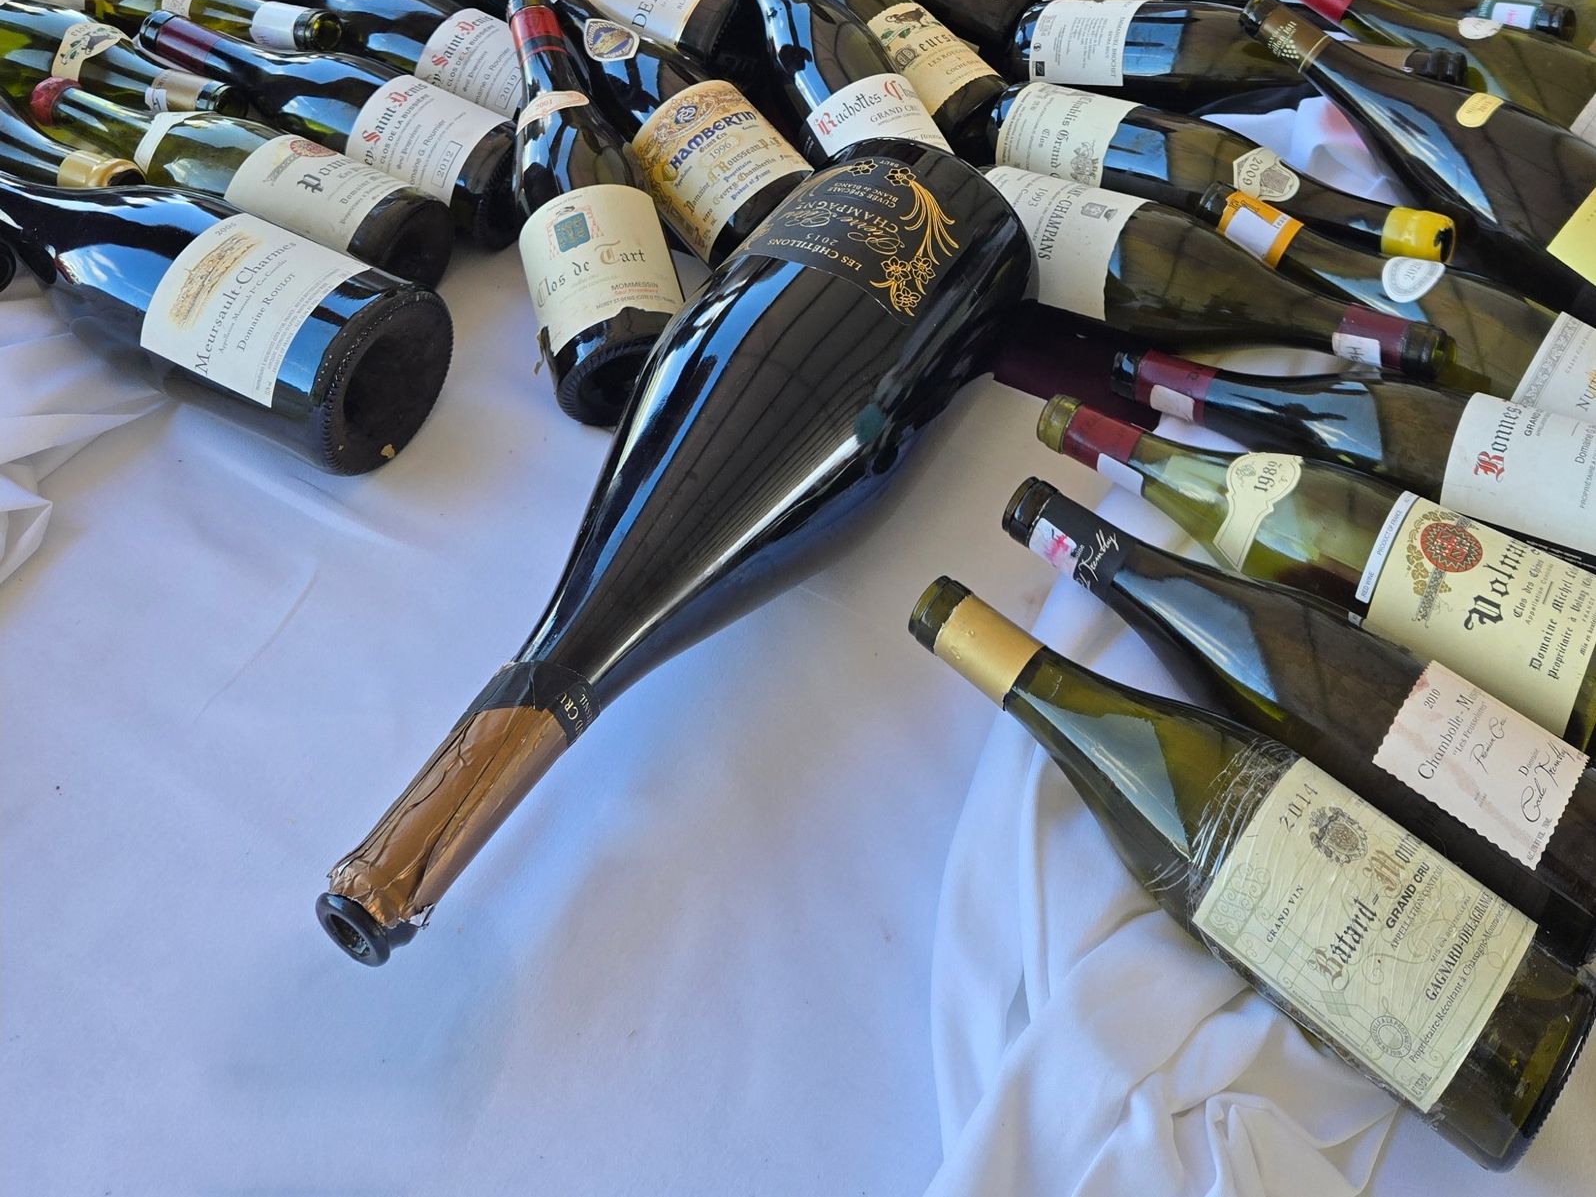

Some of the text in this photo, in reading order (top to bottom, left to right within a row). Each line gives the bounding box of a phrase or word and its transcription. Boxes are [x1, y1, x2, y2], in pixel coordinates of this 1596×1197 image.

[895, 33, 957, 72] Meurs
[500, 74, 518, 101] 2019
[870, 106, 904, 124] GRAND
[380, 140, 392, 165] CLOS
[388, 128, 398, 143] DE
[409, 156, 422, 187] omaine
[424, 118, 447, 147] Roumier
[709, 141, 733, 160] 1996
[1038, 127, 1051, 149] Clos
[1050, 128, 1070, 174] Grand
[436, 150, 455, 179] 2012
[879, 159, 901, 168] BRUT
[1241, 154, 1264, 187] 2009
[826, 186, 897, 210] CUVÉE SPÉCIALE
[870, 189, 900, 203] BLANC
[1026, 186, 1050, 210] 1993
[215, 221, 238, 237] 2005
[572, 261, 591, 277] de
[767, 237, 863, 271] LES CHÉTILLONS
[610, 281, 659, 292] MOMMESSIN
[194, 241, 297, 377] Meursault-Charmes
[236, 305, 267, 353] Domaine
[1474, 405, 1524, 483] Bonnes
[1361, 509, 1403, 598] RED WINE PRODUCT OF FRANCE
[1463, 539, 1529, 631] Volna
[1512, 597, 1526, 619] Clos
[1520, 581, 1535, 597] des
[1525, 591, 1543, 626] Appellation
[1528, 582, 1573, 673] Domaine Michel
[1547, 626, 1575, 681] Propriétaire
[560, 691, 579, 721] CRU
[1423, 688, 1442, 710] 2010
[1417, 715, 1464, 781] Chambolle
[1279, 782, 1320, 832] 2014
[1266, 883, 1306, 944] GRAND VIN
[1386, 861, 1431, 930] GRAND CRU
[1391, 896, 1424, 952] APPELLATION
[1431, 949, 1441, 964] MIS
[1409, 987, 1463, 1065] Propriétaire-Récoltant
